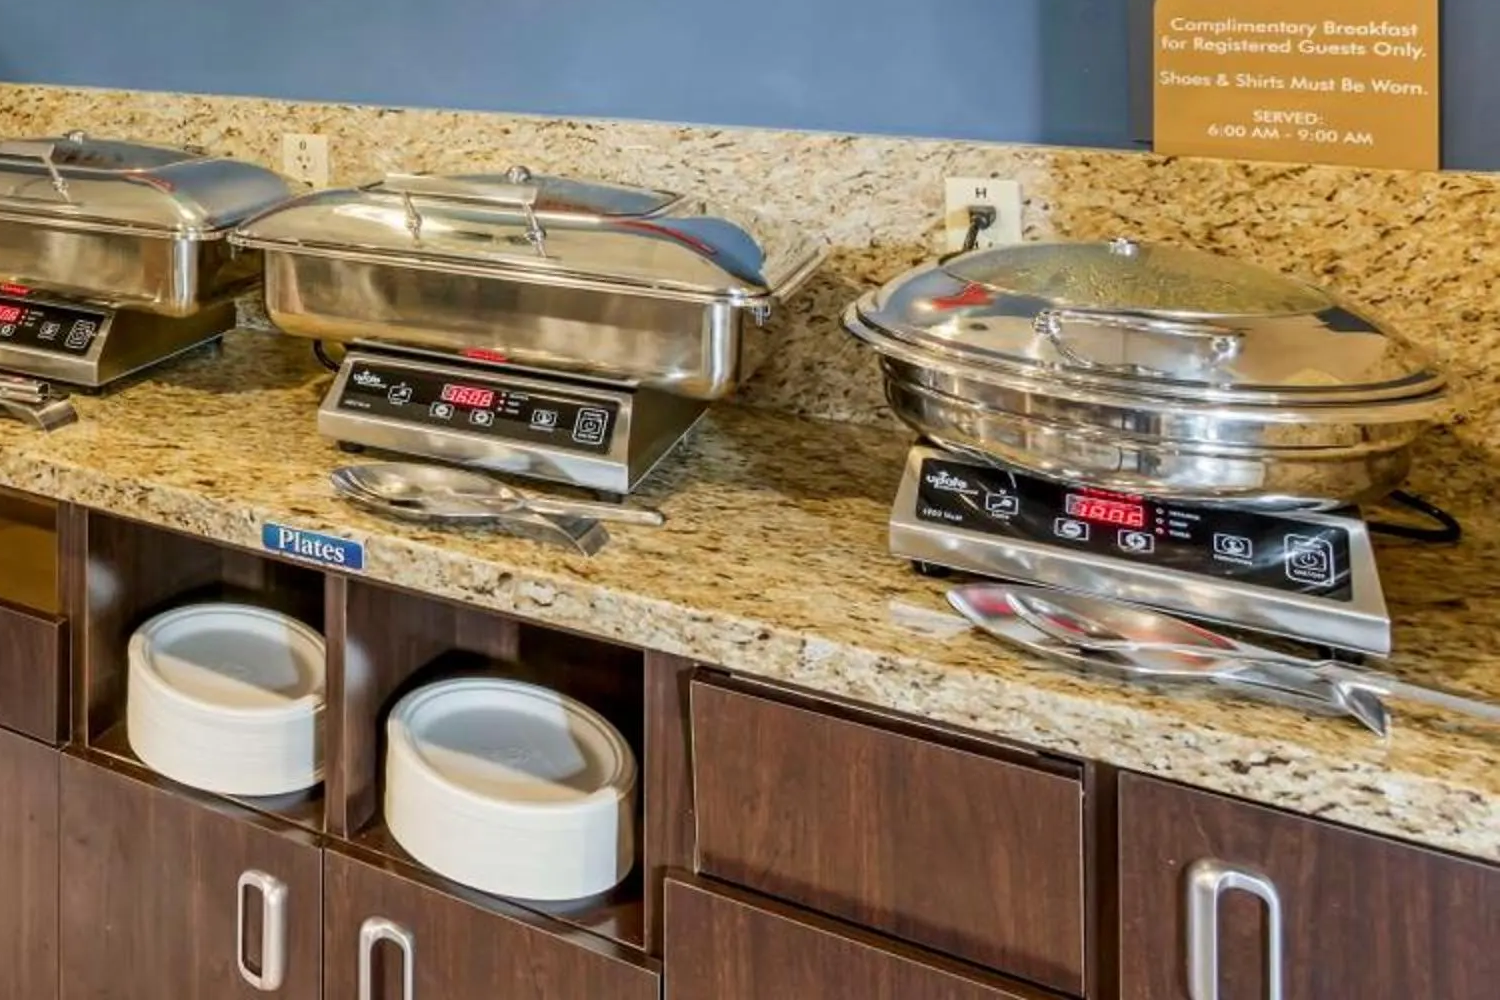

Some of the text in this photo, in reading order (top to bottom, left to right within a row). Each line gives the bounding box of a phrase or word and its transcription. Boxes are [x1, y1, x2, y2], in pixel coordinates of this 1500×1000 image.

[1170, 17, 1418, 38] Complimentary Breakfast
[1161, 34, 1428, 61] for Registered Guests Only.
[1158, 70, 1429, 96] Shoes & Shirts Must Be Worn.
[1253, 109, 1325, 126] SERVED:
[1206, 123, 1247, 138] 6:00
[1251, 125, 1280, 140] AM
[1297, 127, 1338, 143] 9:00
[1343, 130, 1374, 146] AM
[975, 187, 987, 198] H
[278, 527, 346, 563] Plates
